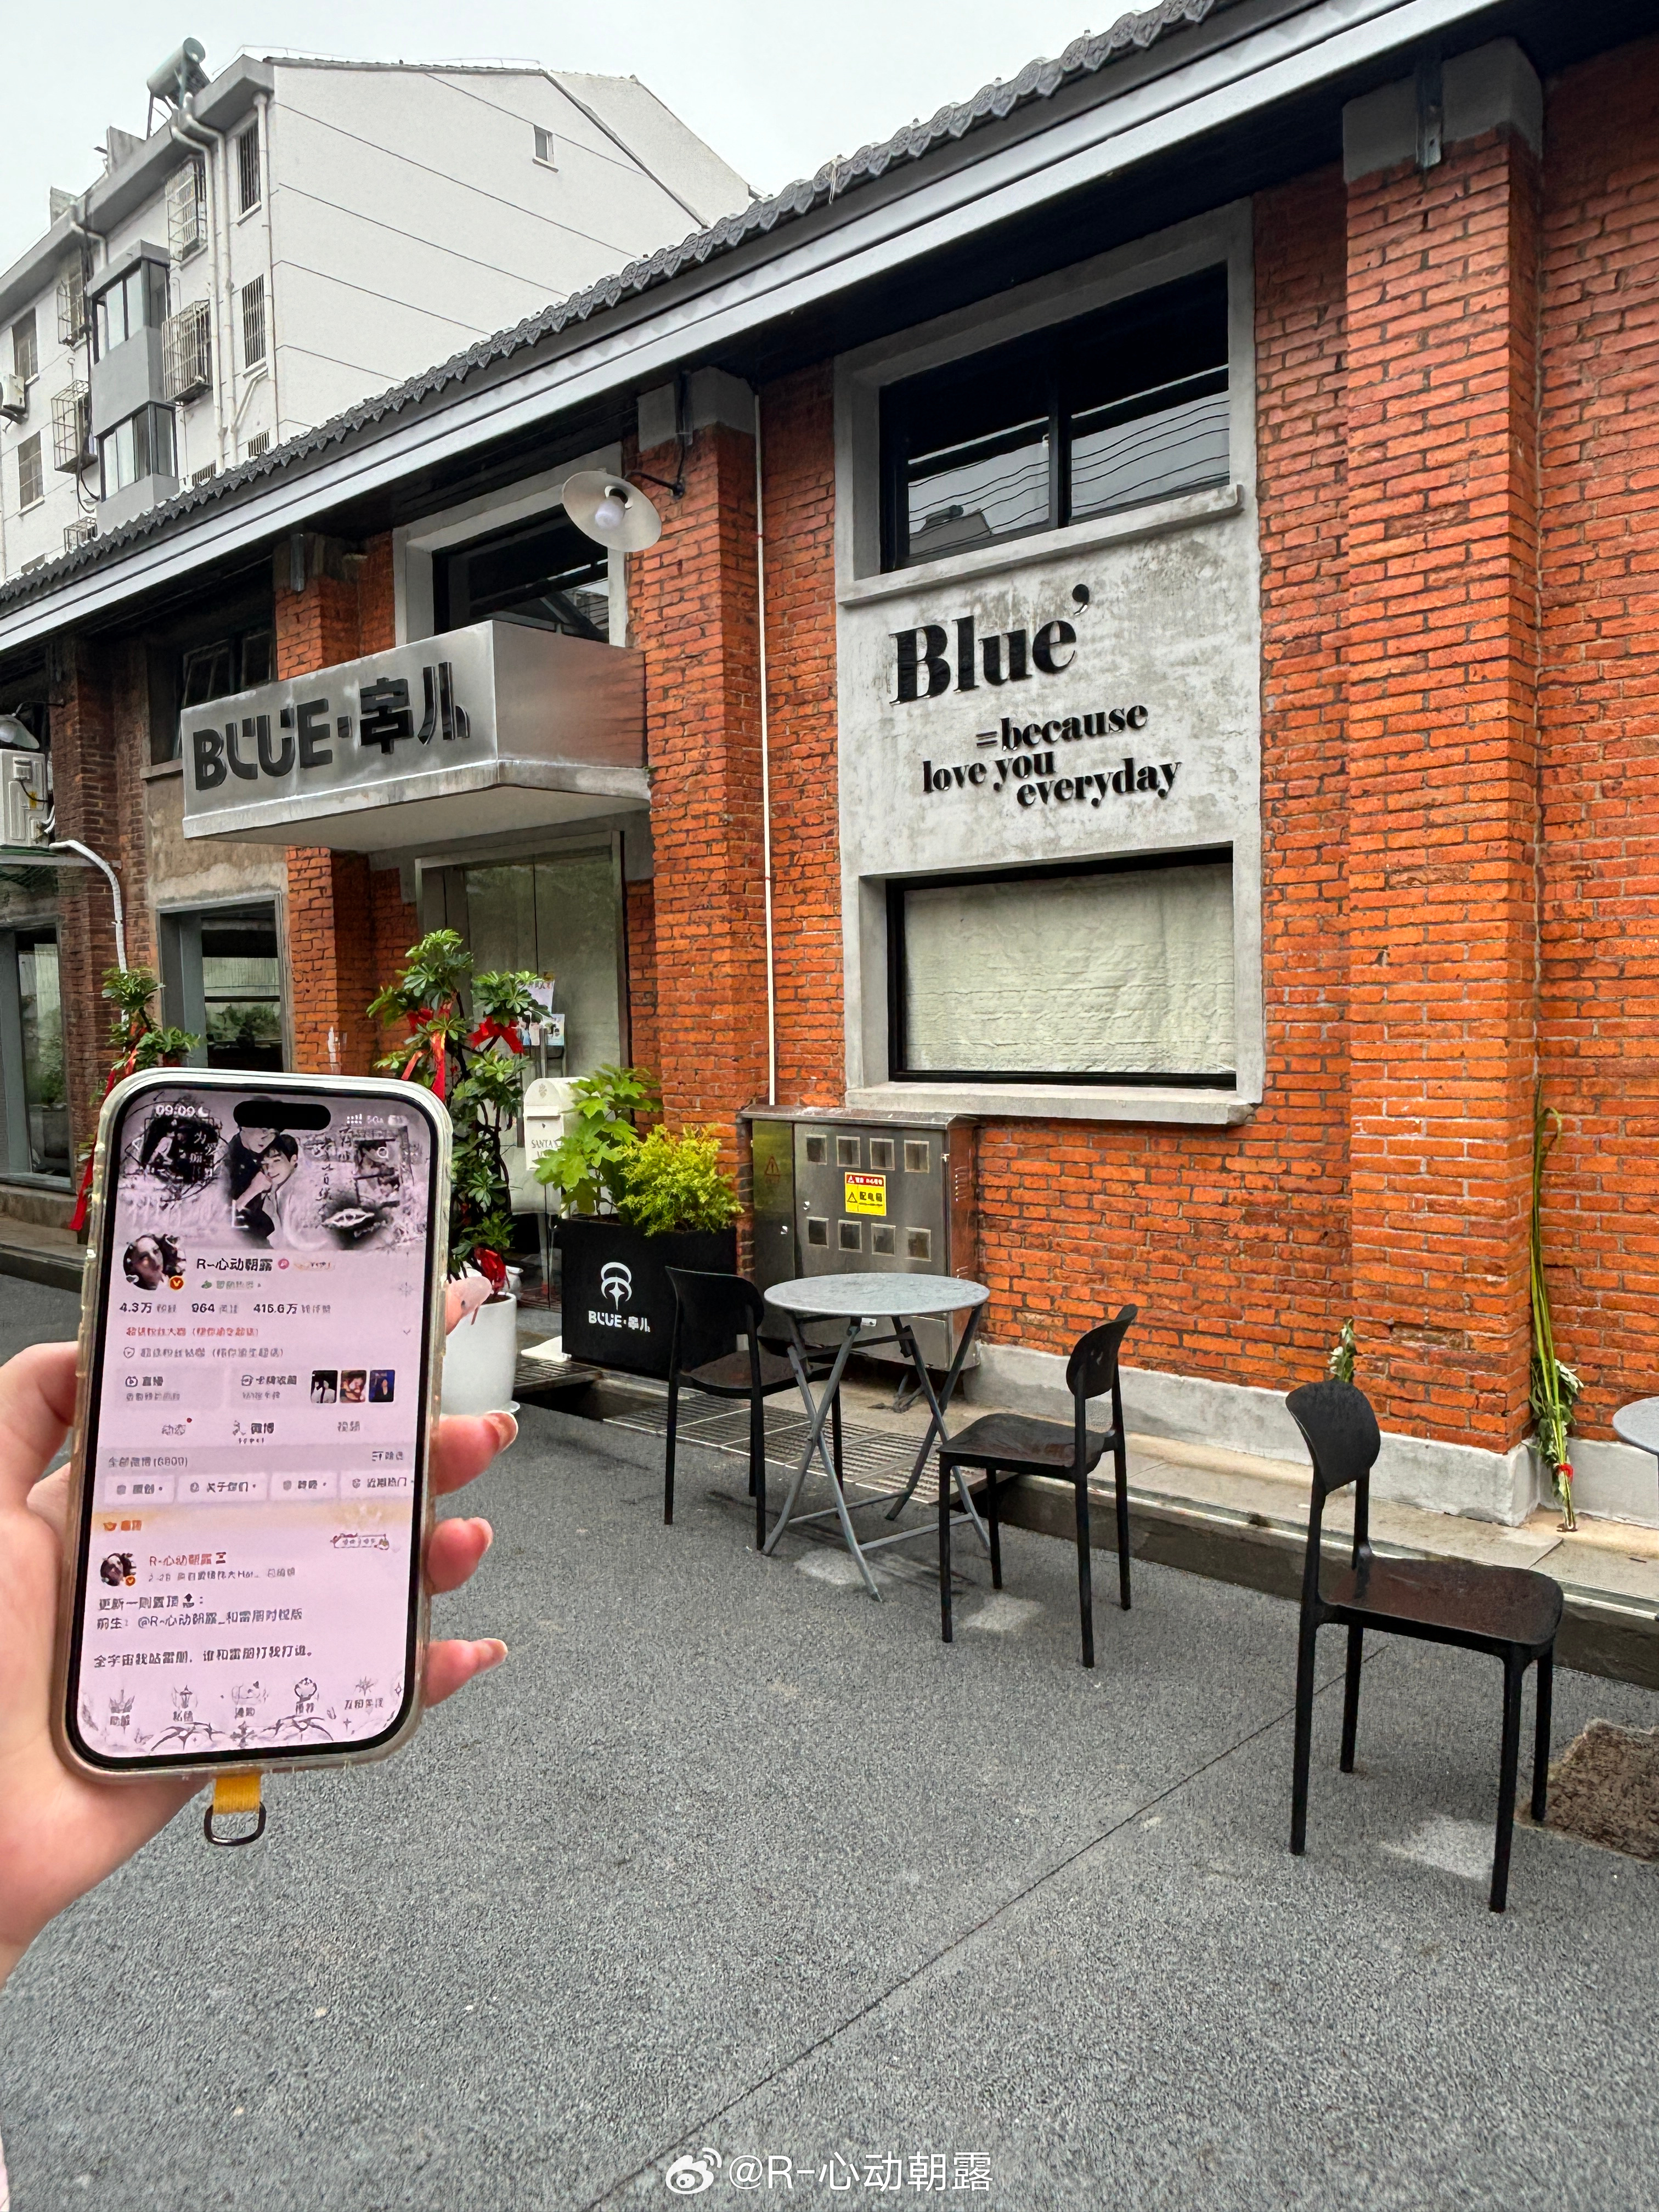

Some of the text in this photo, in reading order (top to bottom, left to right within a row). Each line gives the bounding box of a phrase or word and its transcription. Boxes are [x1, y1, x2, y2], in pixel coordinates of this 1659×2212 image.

[923, 751, 1054, 793] love you
[1017, 758, 1182, 808] everyday
